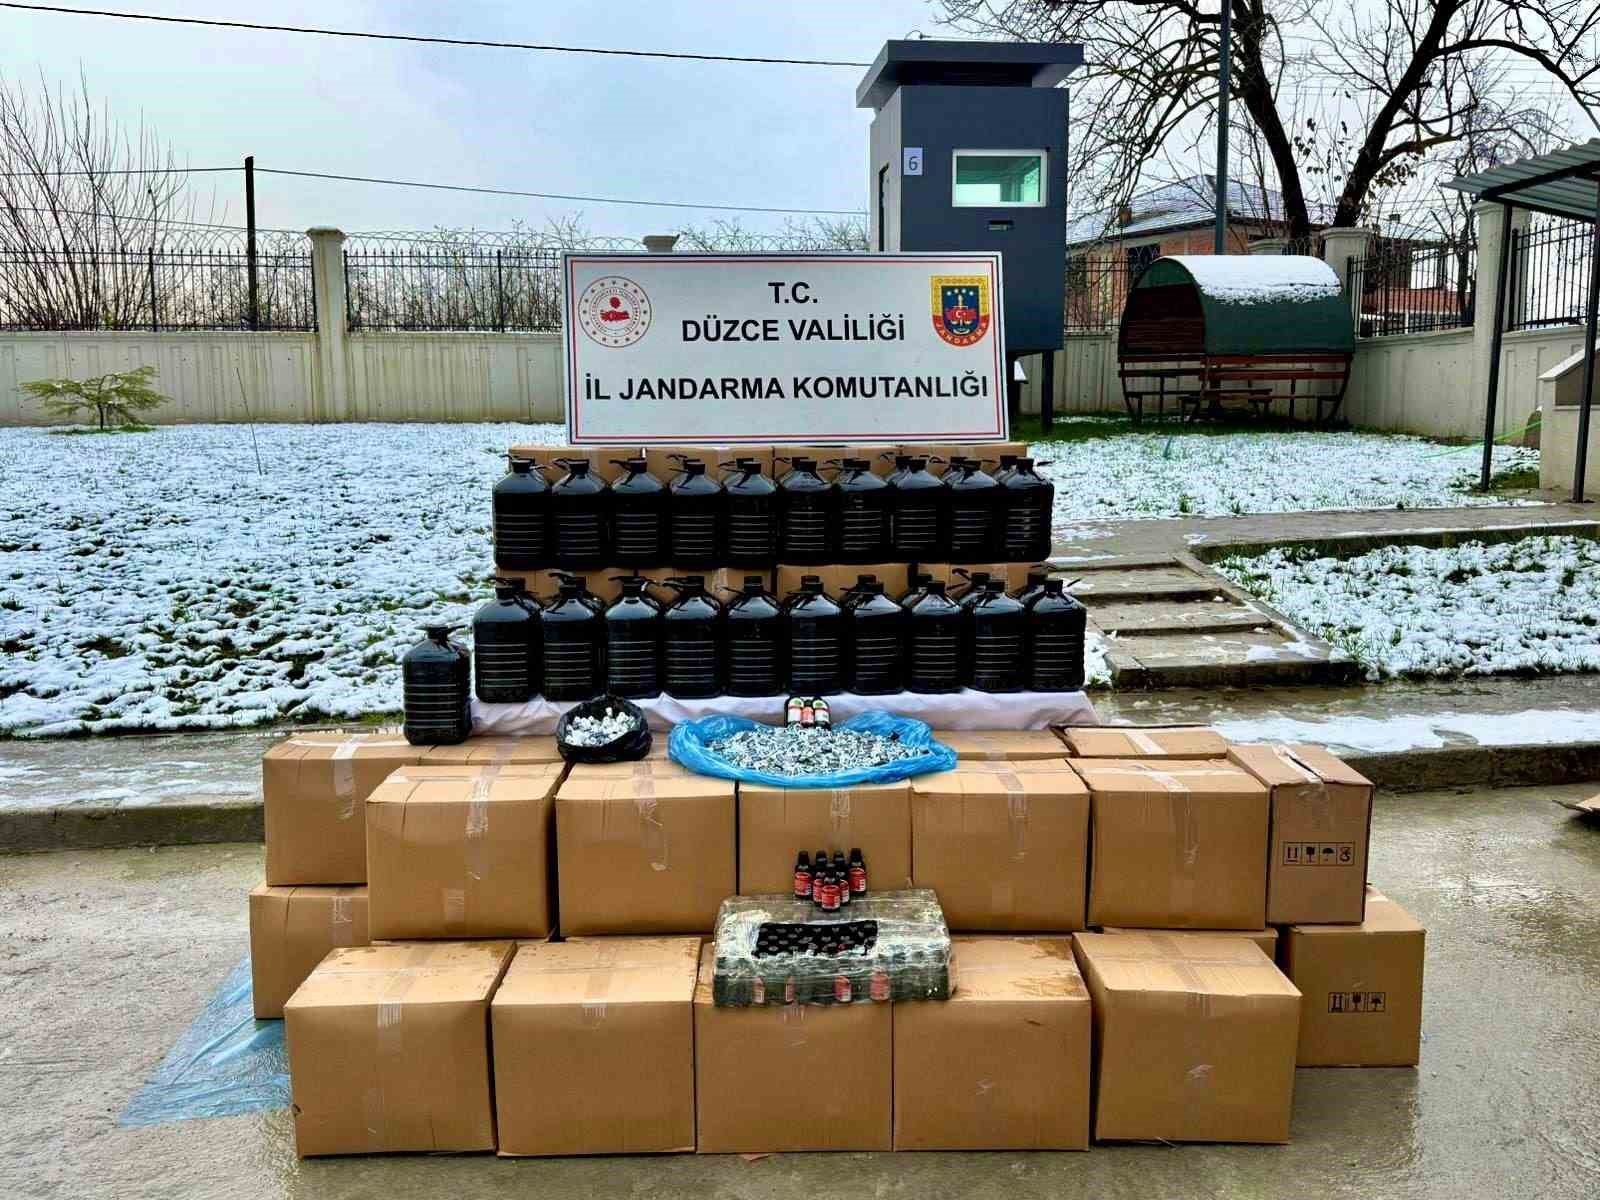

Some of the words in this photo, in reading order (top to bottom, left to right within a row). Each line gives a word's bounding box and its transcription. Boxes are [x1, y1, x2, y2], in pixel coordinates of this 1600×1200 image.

[908, 155, 918, 171] 6
[768, 281, 818, 304] T.C.
[681, 314, 780, 342] DÜZCE
[788, 313, 905, 341] VALİLİĞİ
[585, 372, 610, 400] İL
[619, 377, 785, 400] JANDARMA
[793, 370, 988, 398] KOMUTANLIĞI
